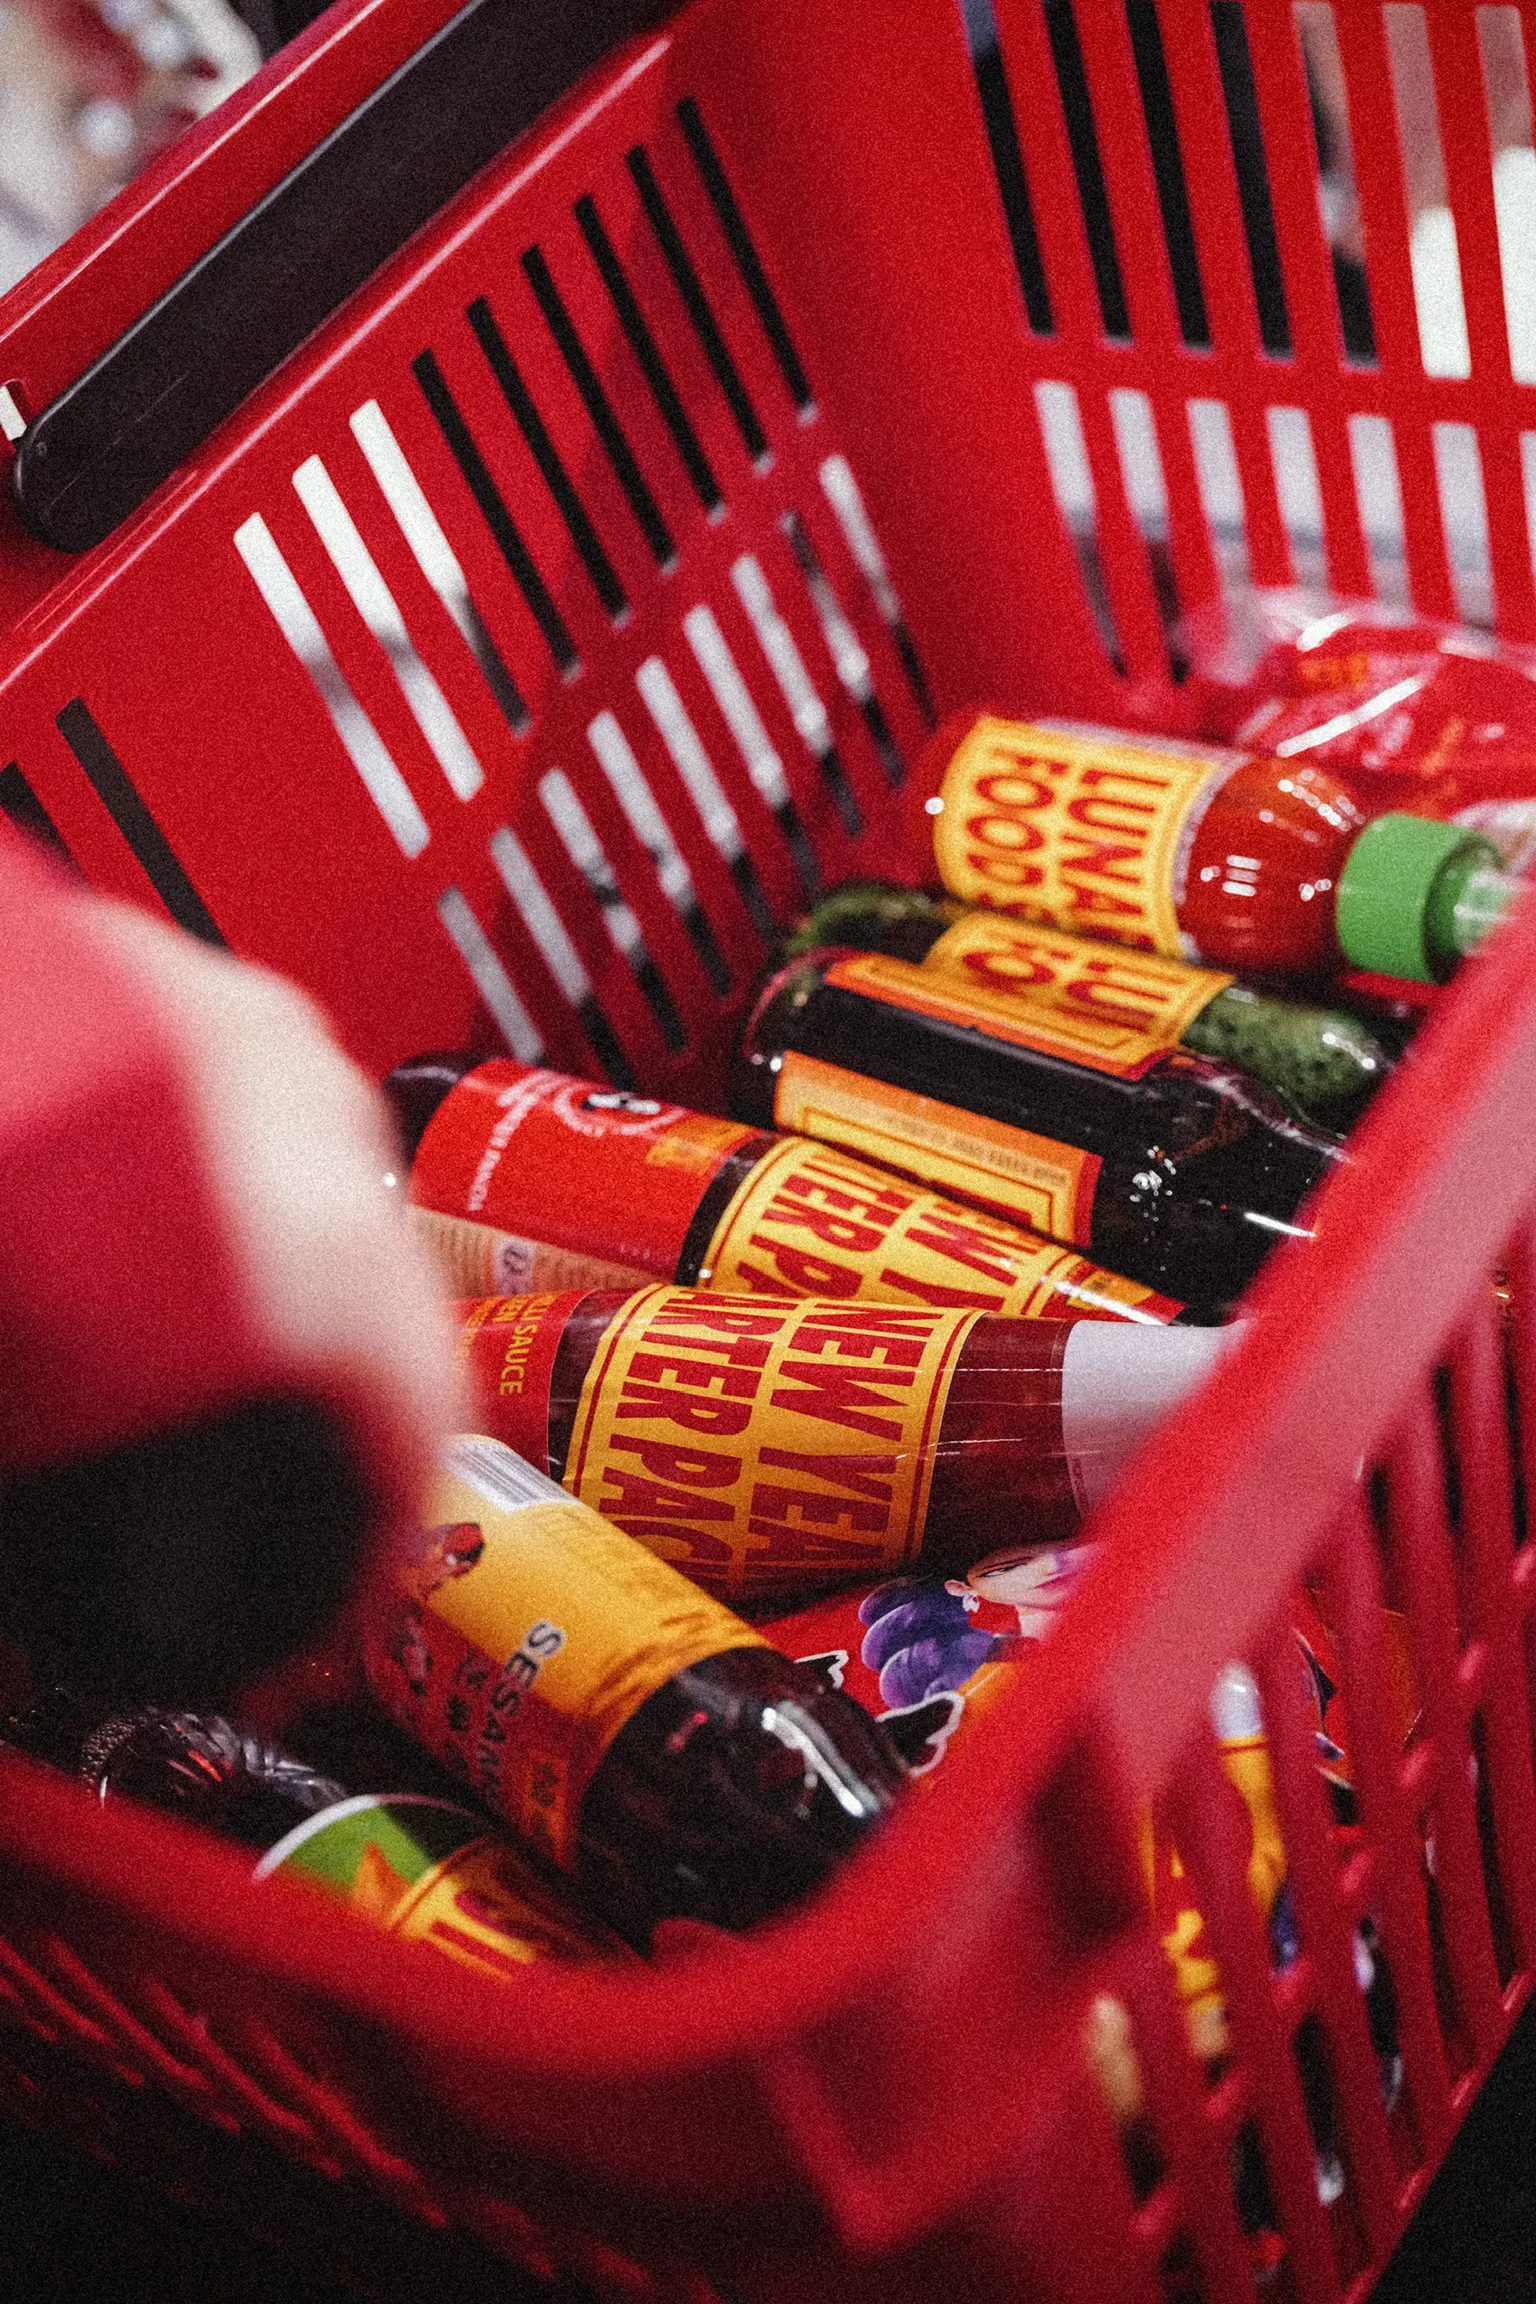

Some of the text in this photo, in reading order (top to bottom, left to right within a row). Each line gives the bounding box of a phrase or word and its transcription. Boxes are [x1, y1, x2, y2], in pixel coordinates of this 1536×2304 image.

[762, 1155, 918, 1253] TER
[499, 1323, 538, 1396] SAUCE
[769, 1302, 944, 1442] NEW
